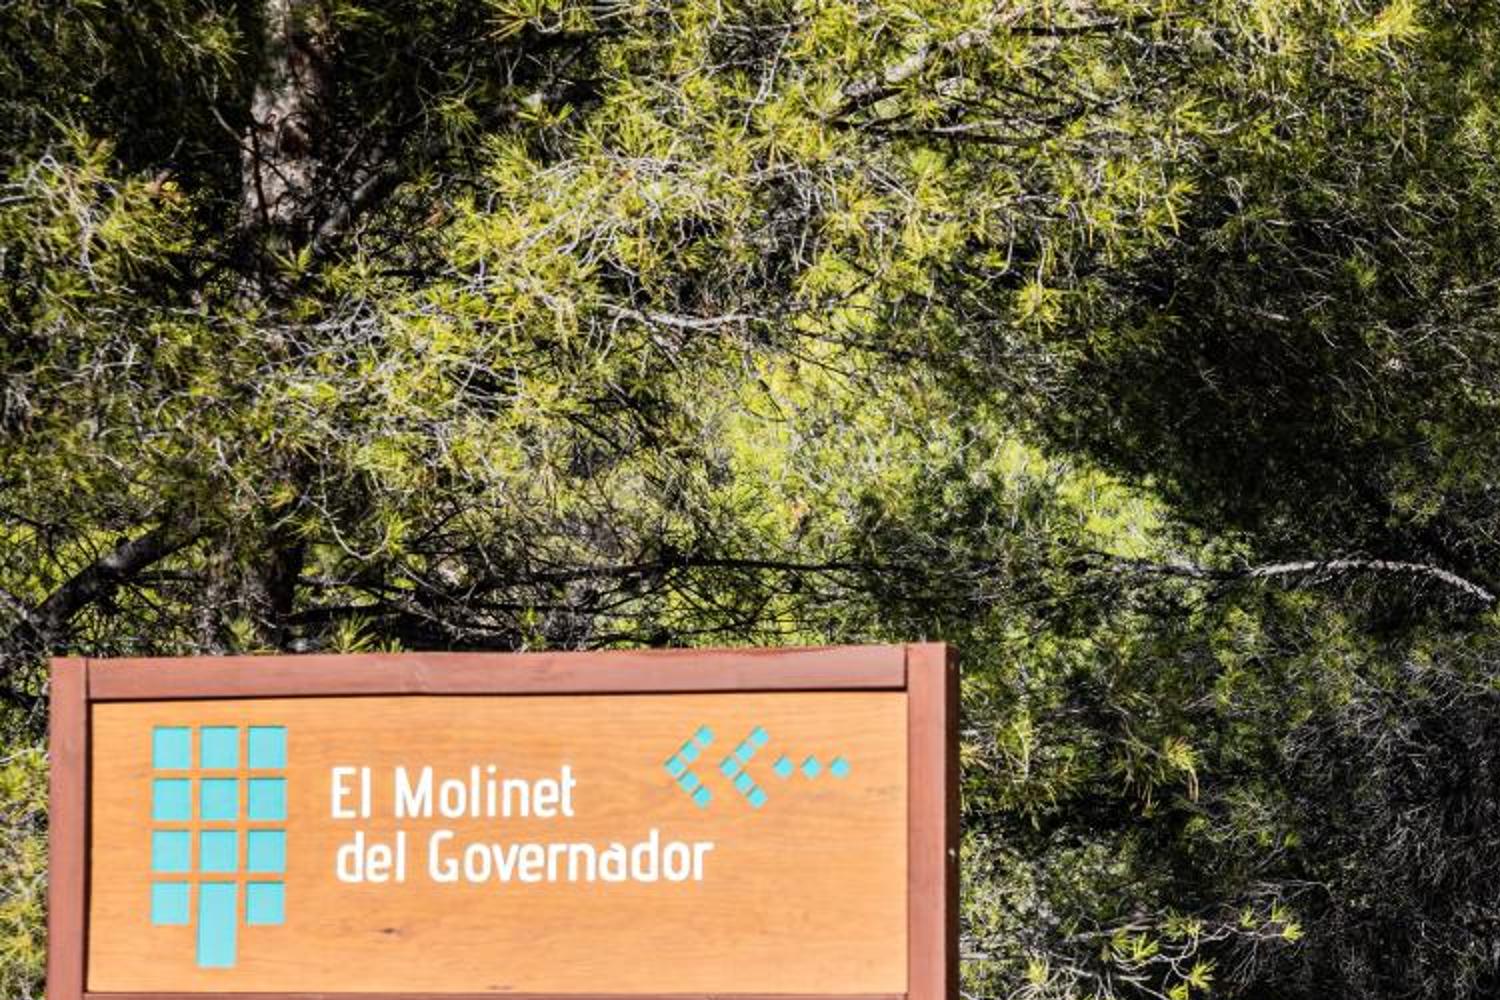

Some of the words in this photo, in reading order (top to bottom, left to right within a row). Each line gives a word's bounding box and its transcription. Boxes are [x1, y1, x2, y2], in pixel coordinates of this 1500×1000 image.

[331, 766, 371, 819] El
[394, 765, 577, 819] Molinet
[336, 829, 406, 883] del
[428, 829, 714, 883] Governador
